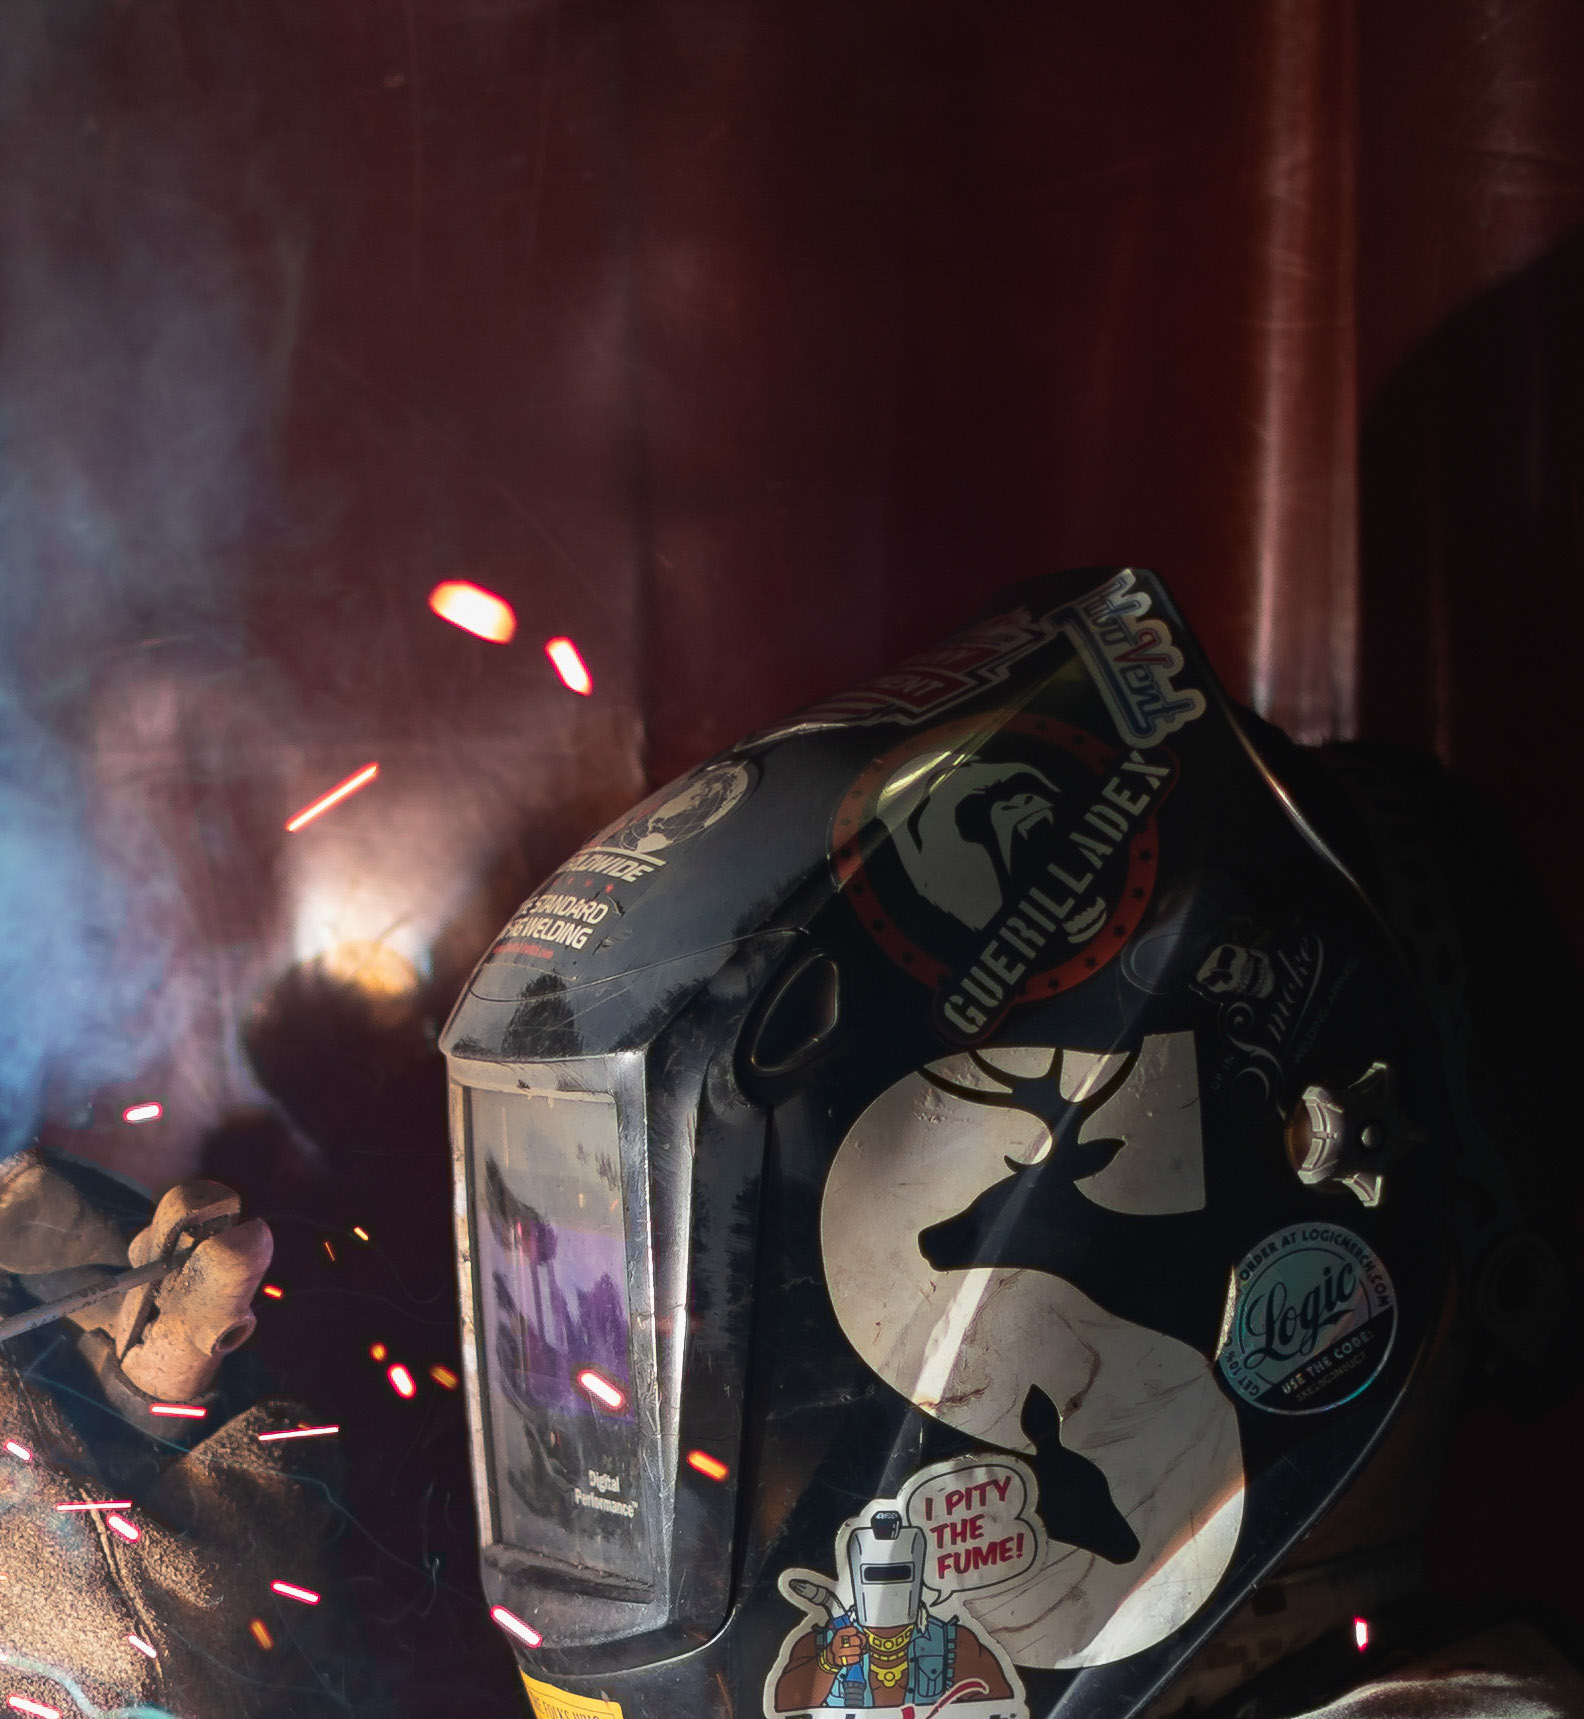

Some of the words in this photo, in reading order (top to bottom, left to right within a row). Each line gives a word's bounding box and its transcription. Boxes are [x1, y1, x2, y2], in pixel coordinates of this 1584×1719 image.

[530, 894, 608, 925] STANDARD
[944, 750, 1171, 1034] GUERILLADEX
[524, 919, 593, 950] WELDING
[1239, 1242, 1278, 1282] ORDER
[1281, 1231, 1297, 1248] AT
[1302, 1229, 1392, 1307] LOGICMERCH.COM
[1244, 1262, 1355, 1370] Logic
[1281, 1371, 1306, 1395] USE
[1306, 1355, 1333, 1378] THE
[1333, 1330, 1375, 1360] CODE:
[1237, 1375, 1260, 1397] GET
[588, 1469, 620, 1494] Digital
[924, 1497, 933, 1521] I
[945, 1475, 1012, 1509] PITY
[930, 1513, 985, 1549] THE
[936, 1532, 1026, 1580] FUME!
